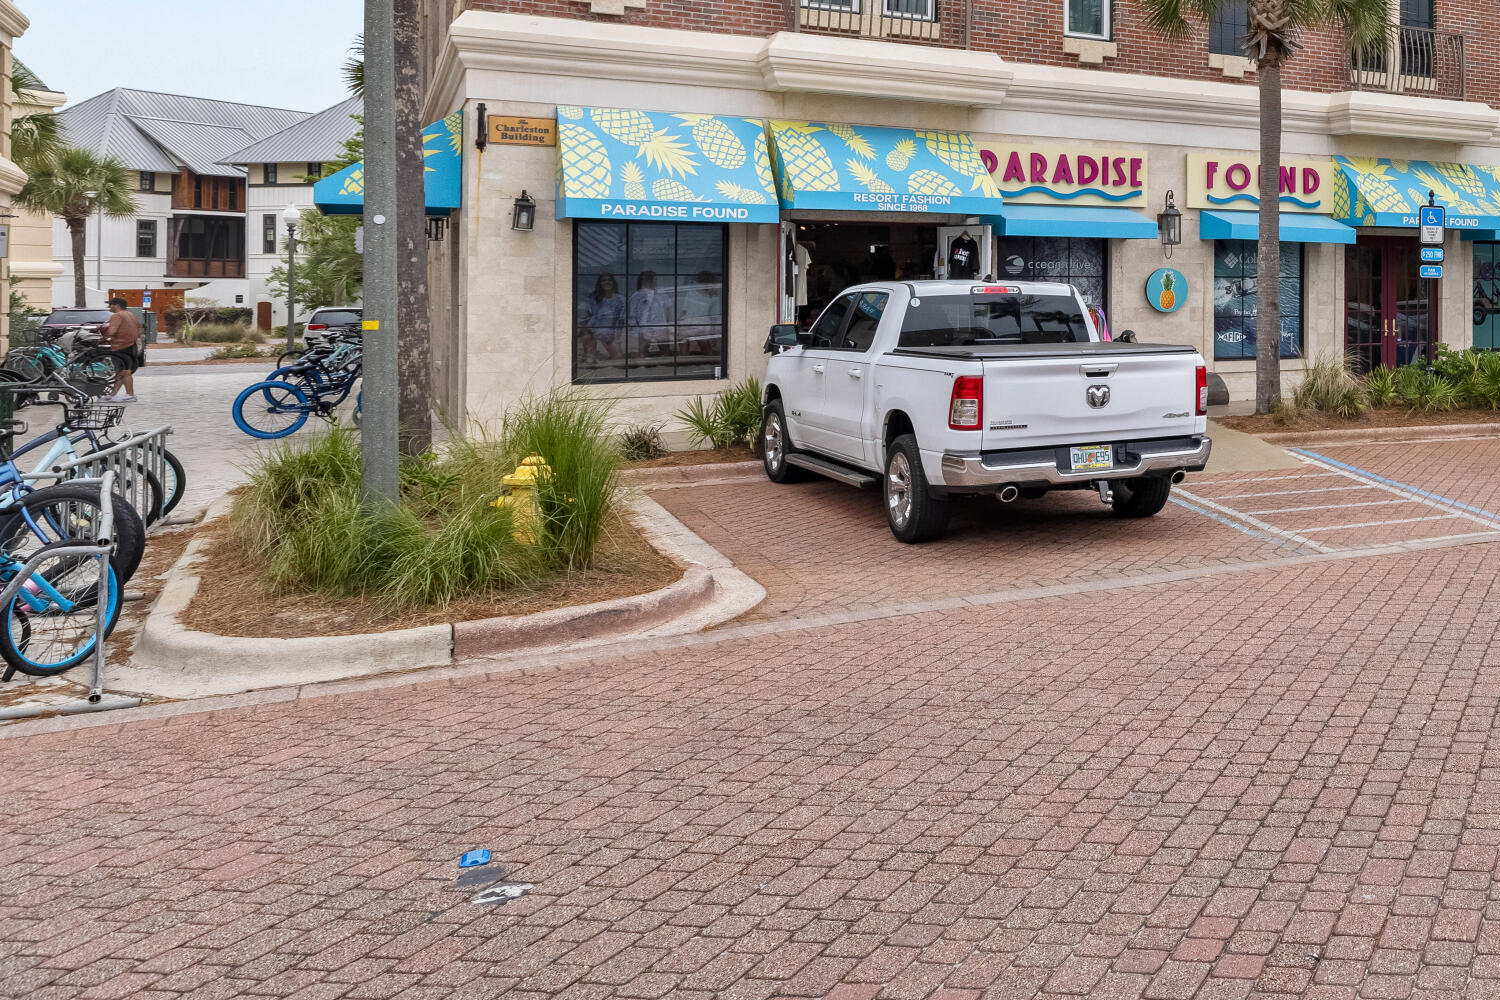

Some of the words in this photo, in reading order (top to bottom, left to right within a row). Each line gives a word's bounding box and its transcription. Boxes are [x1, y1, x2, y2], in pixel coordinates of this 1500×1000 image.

[495, 123, 550, 134] Charleston
[501, 132, 545, 143] Building
[1206, 161, 1320, 195] FOND
[853, 193, 899, 203] RESORT
[902, 195, 951, 205] FASHION
[601, 203, 689, 218] PARADISE
[692, 207, 749, 219] FOUND
[878, 203, 907, 211] SINCE
[1449, 218, 1479, 227] FOUND
